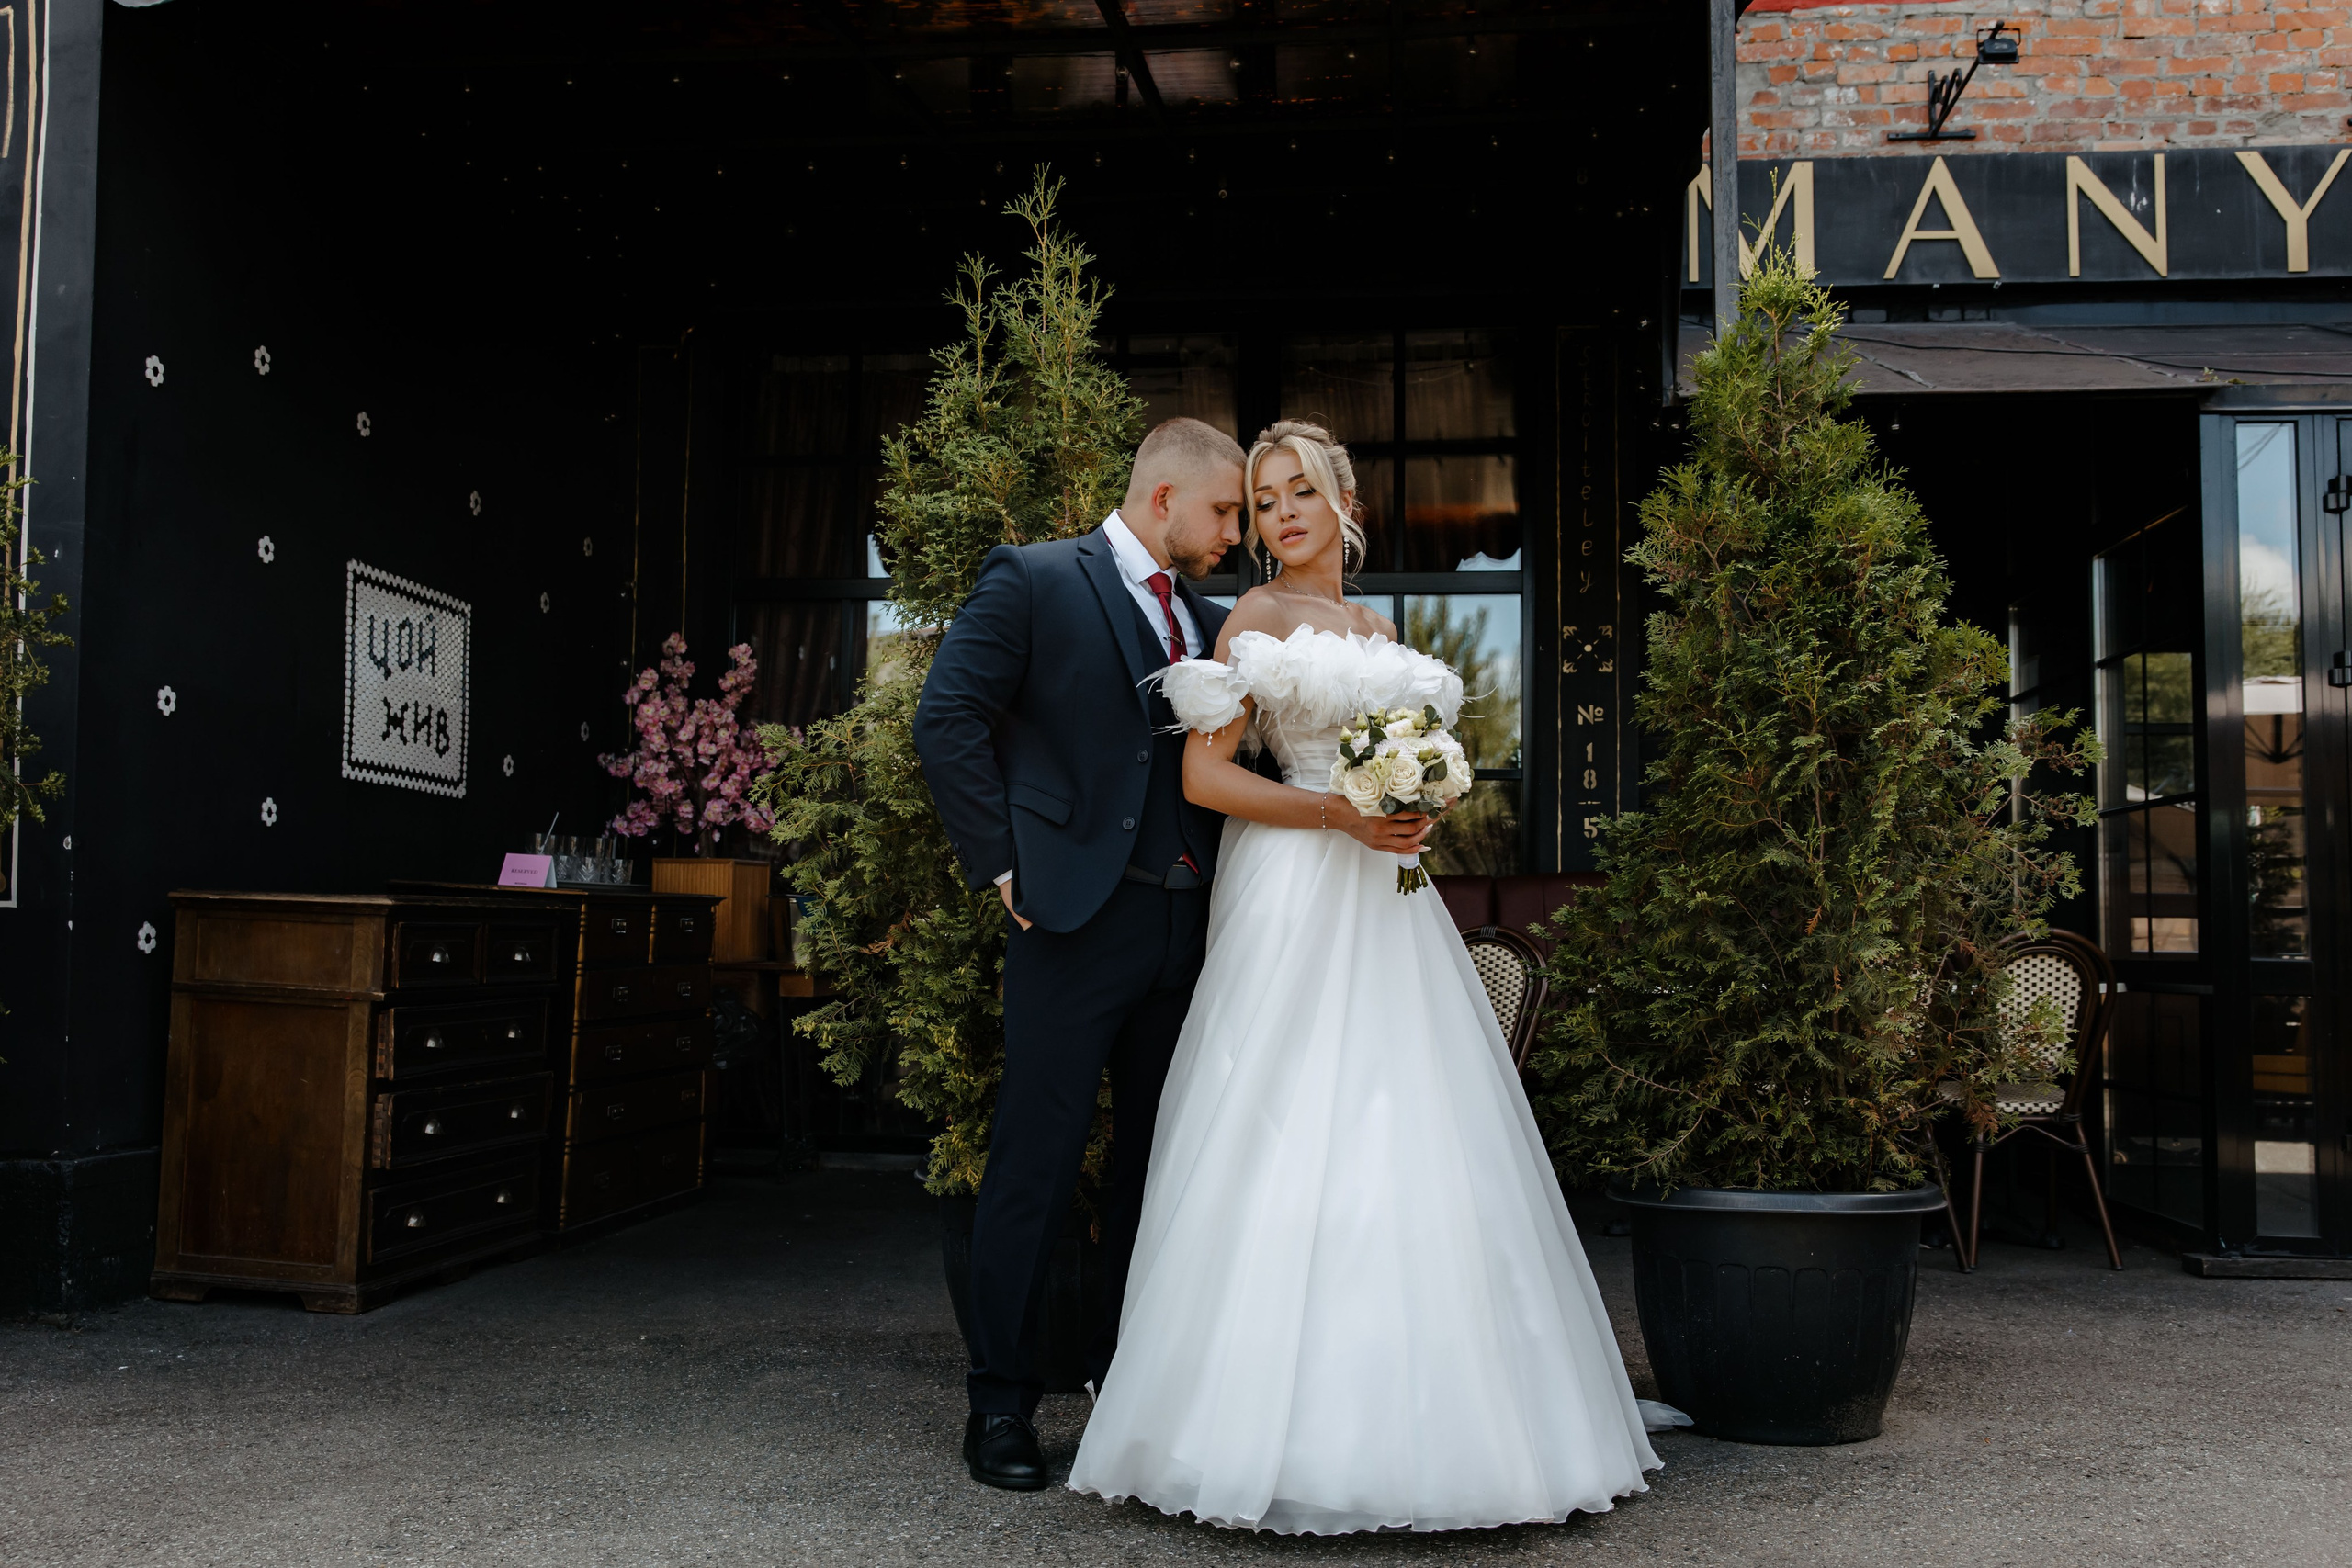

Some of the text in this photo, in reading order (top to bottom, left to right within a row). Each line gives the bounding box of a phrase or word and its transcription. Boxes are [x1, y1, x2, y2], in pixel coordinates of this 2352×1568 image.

[1688, 148, 2352, 283] MANY
[368, 613, 436, 681] ЦОЙ
[382, 696, 449, 758] ЖИВ
